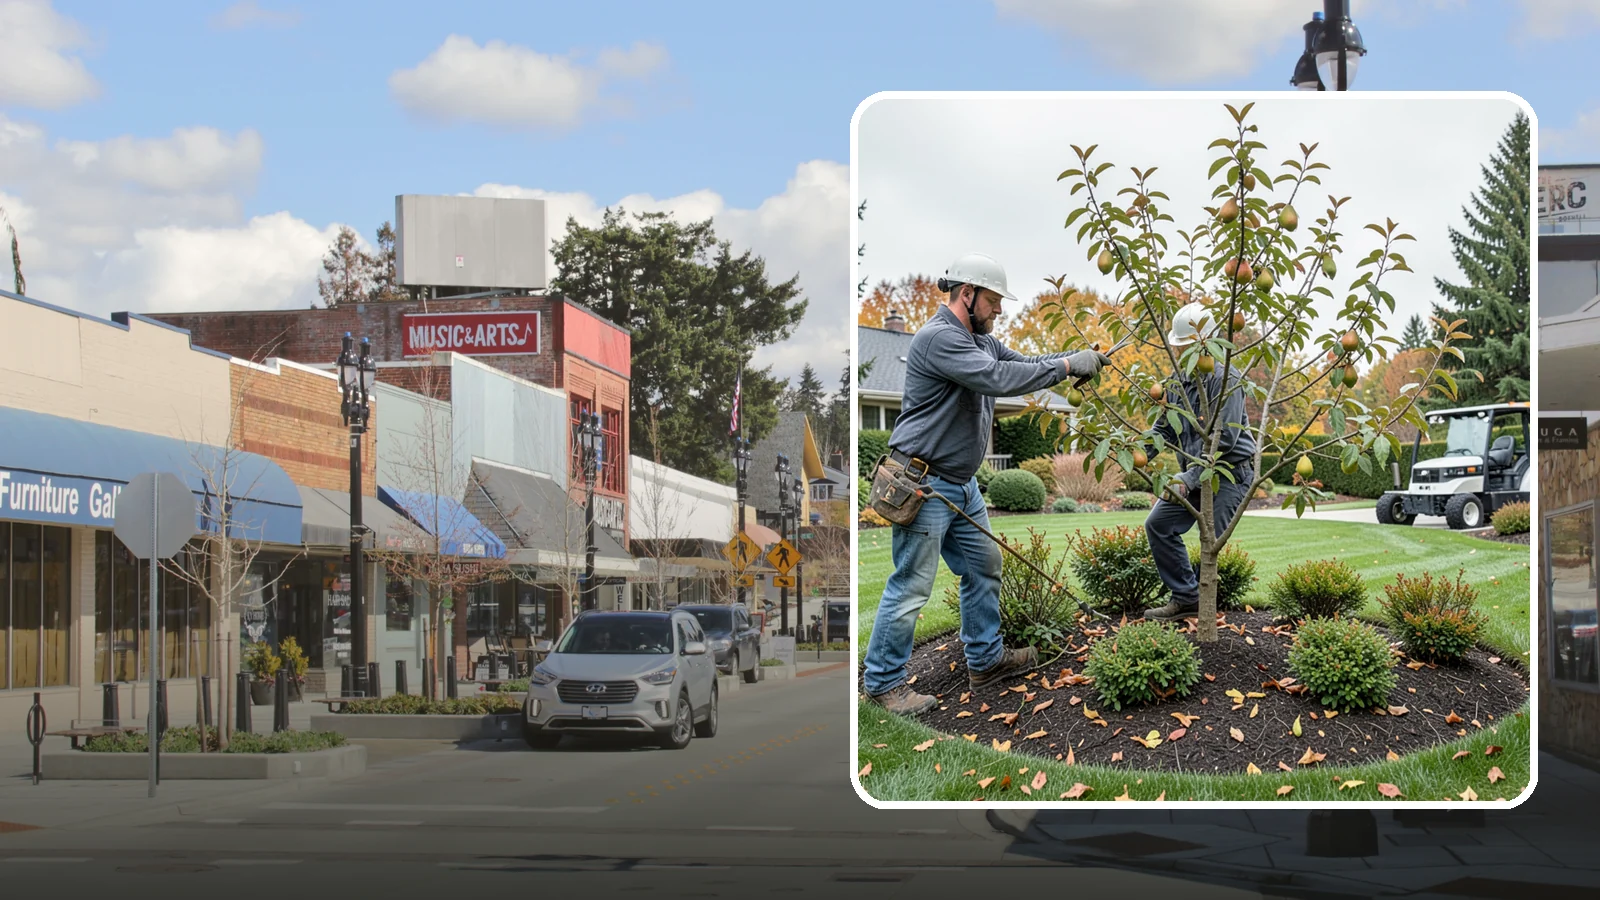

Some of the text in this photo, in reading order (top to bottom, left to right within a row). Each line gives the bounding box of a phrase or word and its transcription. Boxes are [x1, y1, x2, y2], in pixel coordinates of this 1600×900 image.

[409, 323, 519, 349] MUSIC&ARTS
[1540, 427, 1577, 437] UGA
[0, 472, 122, 519] Furniture Gal
